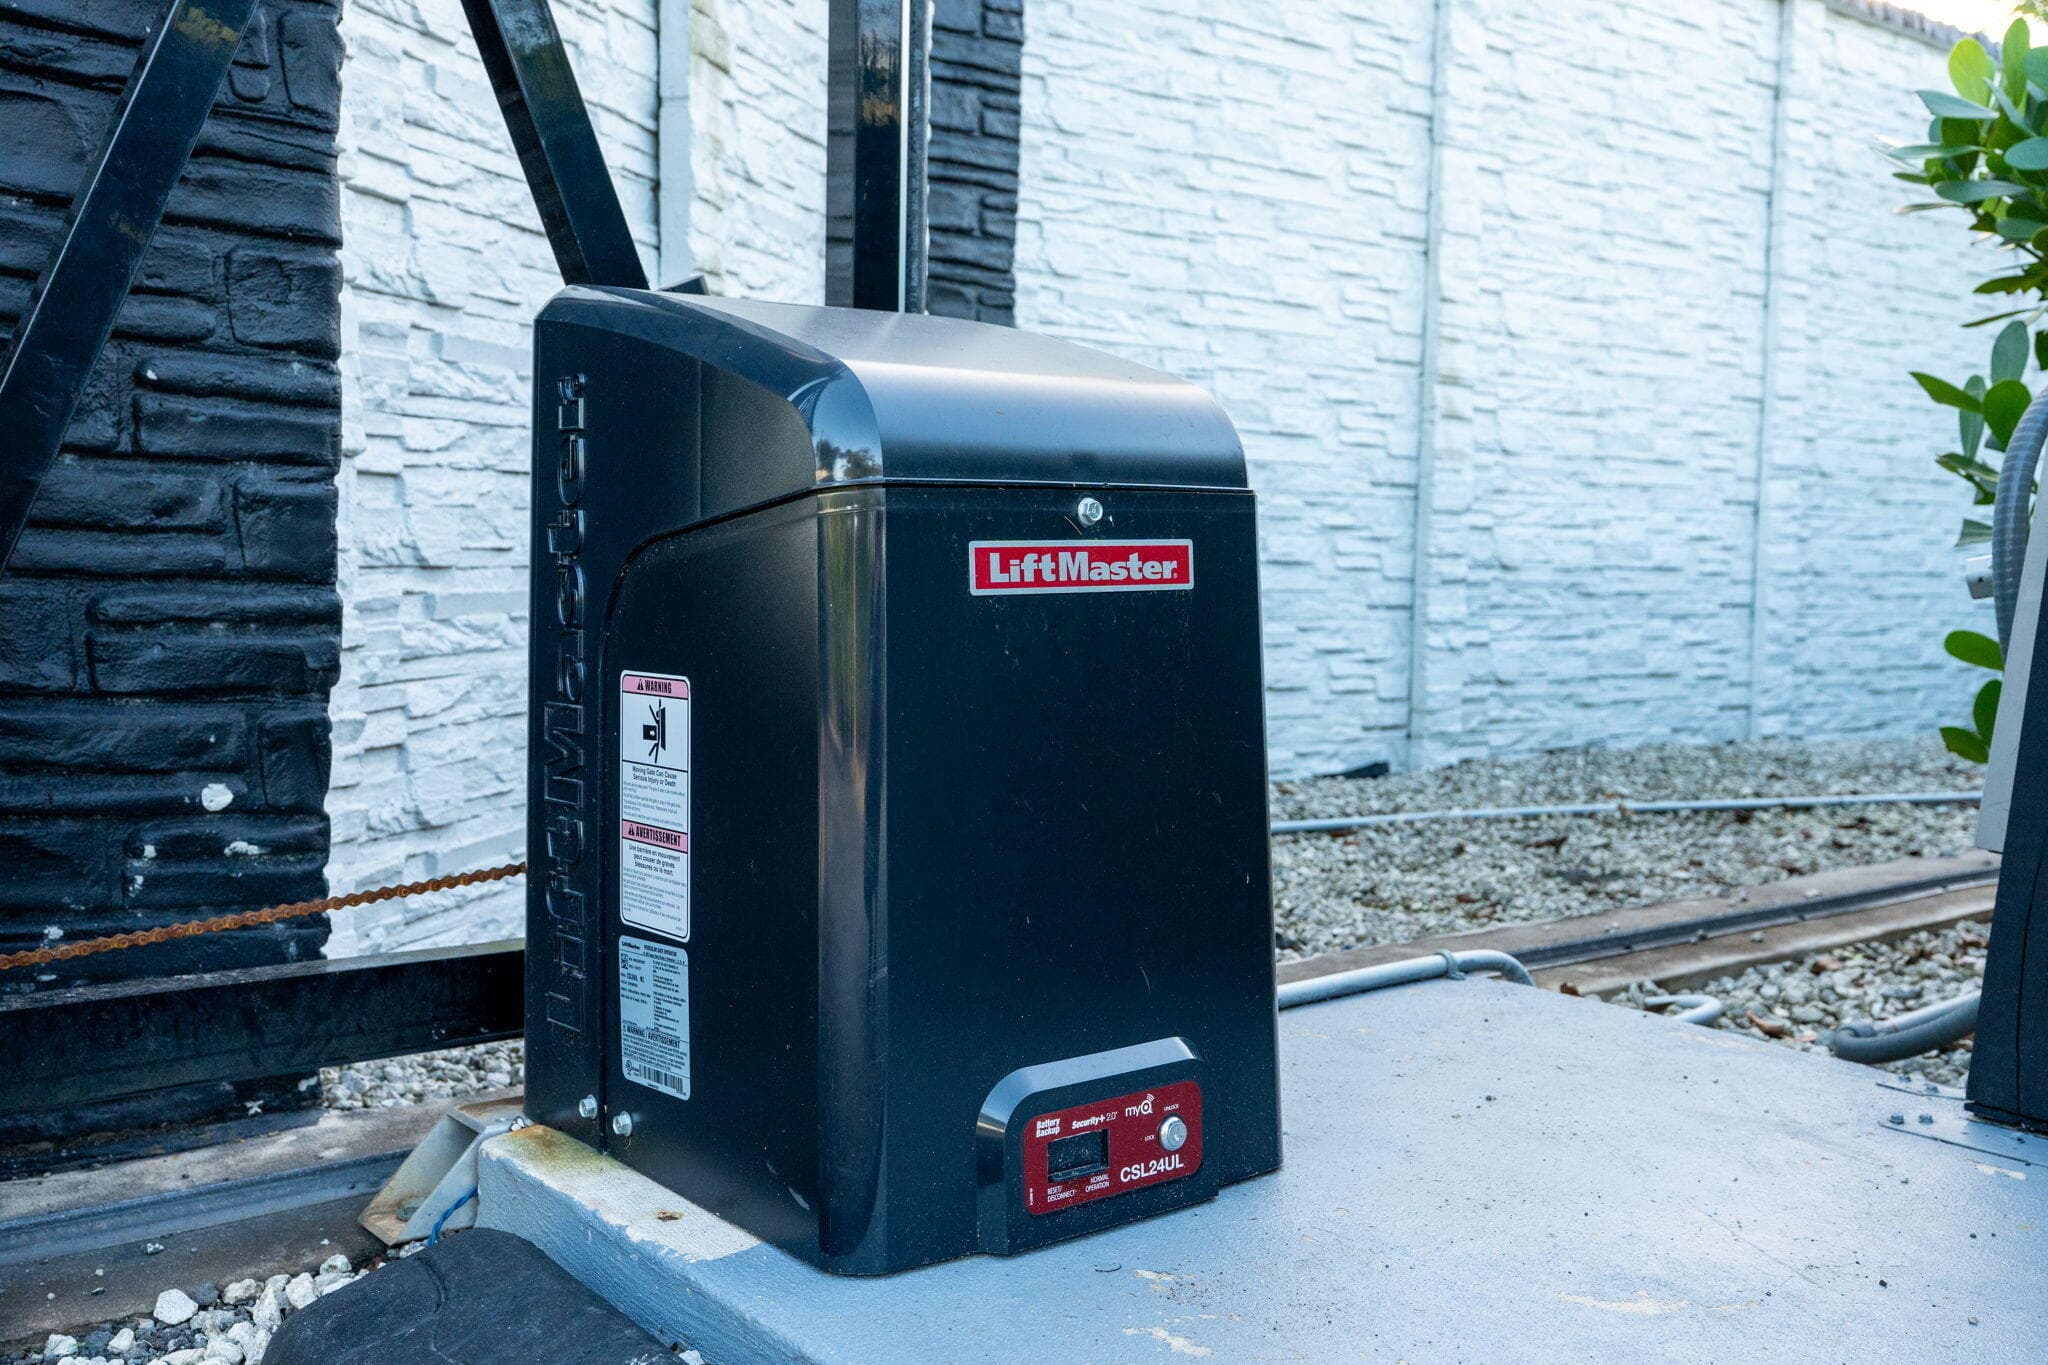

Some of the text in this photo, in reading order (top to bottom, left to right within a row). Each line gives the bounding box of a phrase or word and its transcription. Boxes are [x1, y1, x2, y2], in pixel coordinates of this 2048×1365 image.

[989, 551, 1178, 583] LiftMaster
[644, 680, 672, 694] WARNING
[632, 766, 646, 775] Moving
[665, 771, 677, 780] Cause
[633, 773, 647, 781] Serious
[648, 776, 658, 786] Injury
[636, 826, 680, 846] AVERTISSEMENT
[627, 1026, 645, 1037] WARNING
[1125, 1100, 1152, 1117] myQ
[1036, 1118, 1060, 1130] Battery
[1072, 1115, 1105, 1129] Security+
[1036, 1126, 1060, 1138] Backup
[1120, 1154, 1184, 1182] CSL24UL
[1091, 1173, 1109, 1183] NORMAL
[1085, 1181, 1110, 1192] OPERATION
[1048, 1190, 1075, 1202] DISCONNECT
